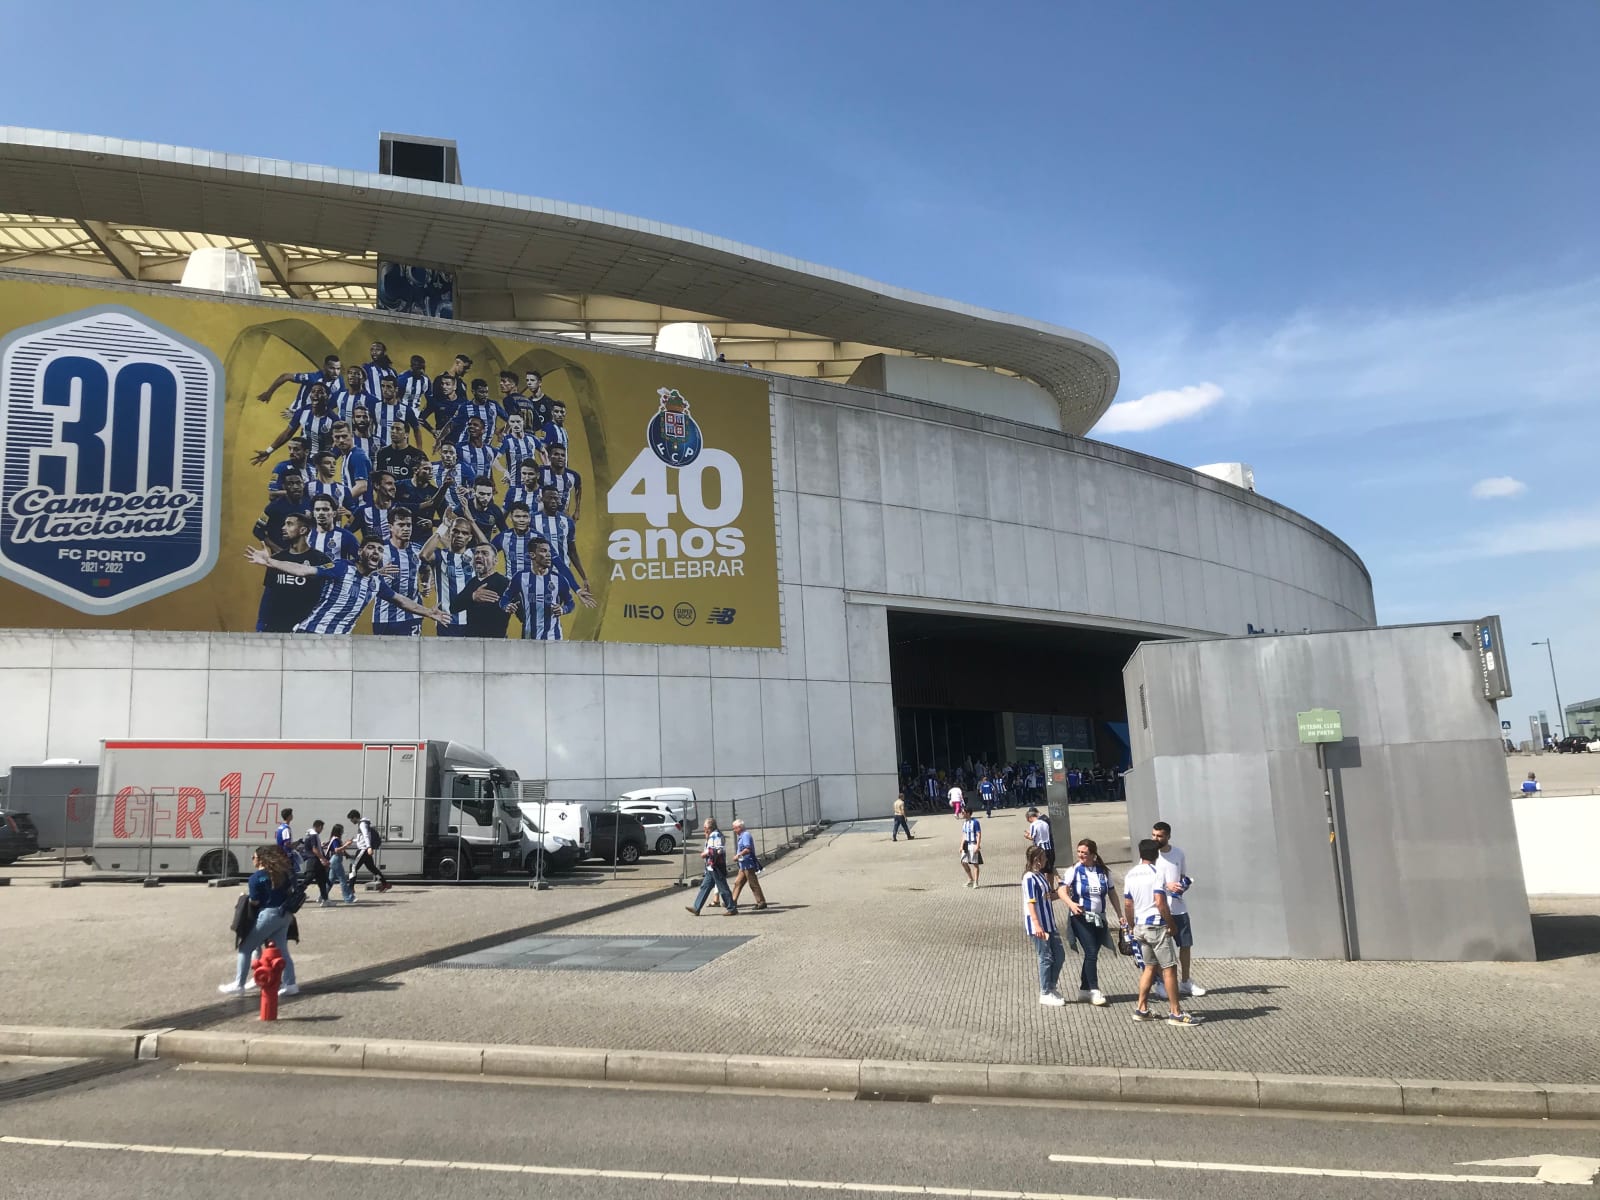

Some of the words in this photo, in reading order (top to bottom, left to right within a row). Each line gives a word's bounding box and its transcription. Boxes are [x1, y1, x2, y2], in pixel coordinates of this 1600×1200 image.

[37, 356, 178, 494] 30
[10, 486, 196, 517] Campeão
[607, 447, 743, 527] 40
[14, 512, 185, 542] Nacional
[58, 548, 82, 560] FC
[86, 549, 146, 562] PORTO
[607, 526, 746, 560] anos
[80, 561, 98, 573] 2021
[104, 562, 124, 573] 2022
[610, 563, 626, 581] A
[631, 559, 745, 580] CELEBRAR
[623, 604, 664, 620] MEO
[113, 786, 206, 839] GER
[220, 772, 281, 839] 14
